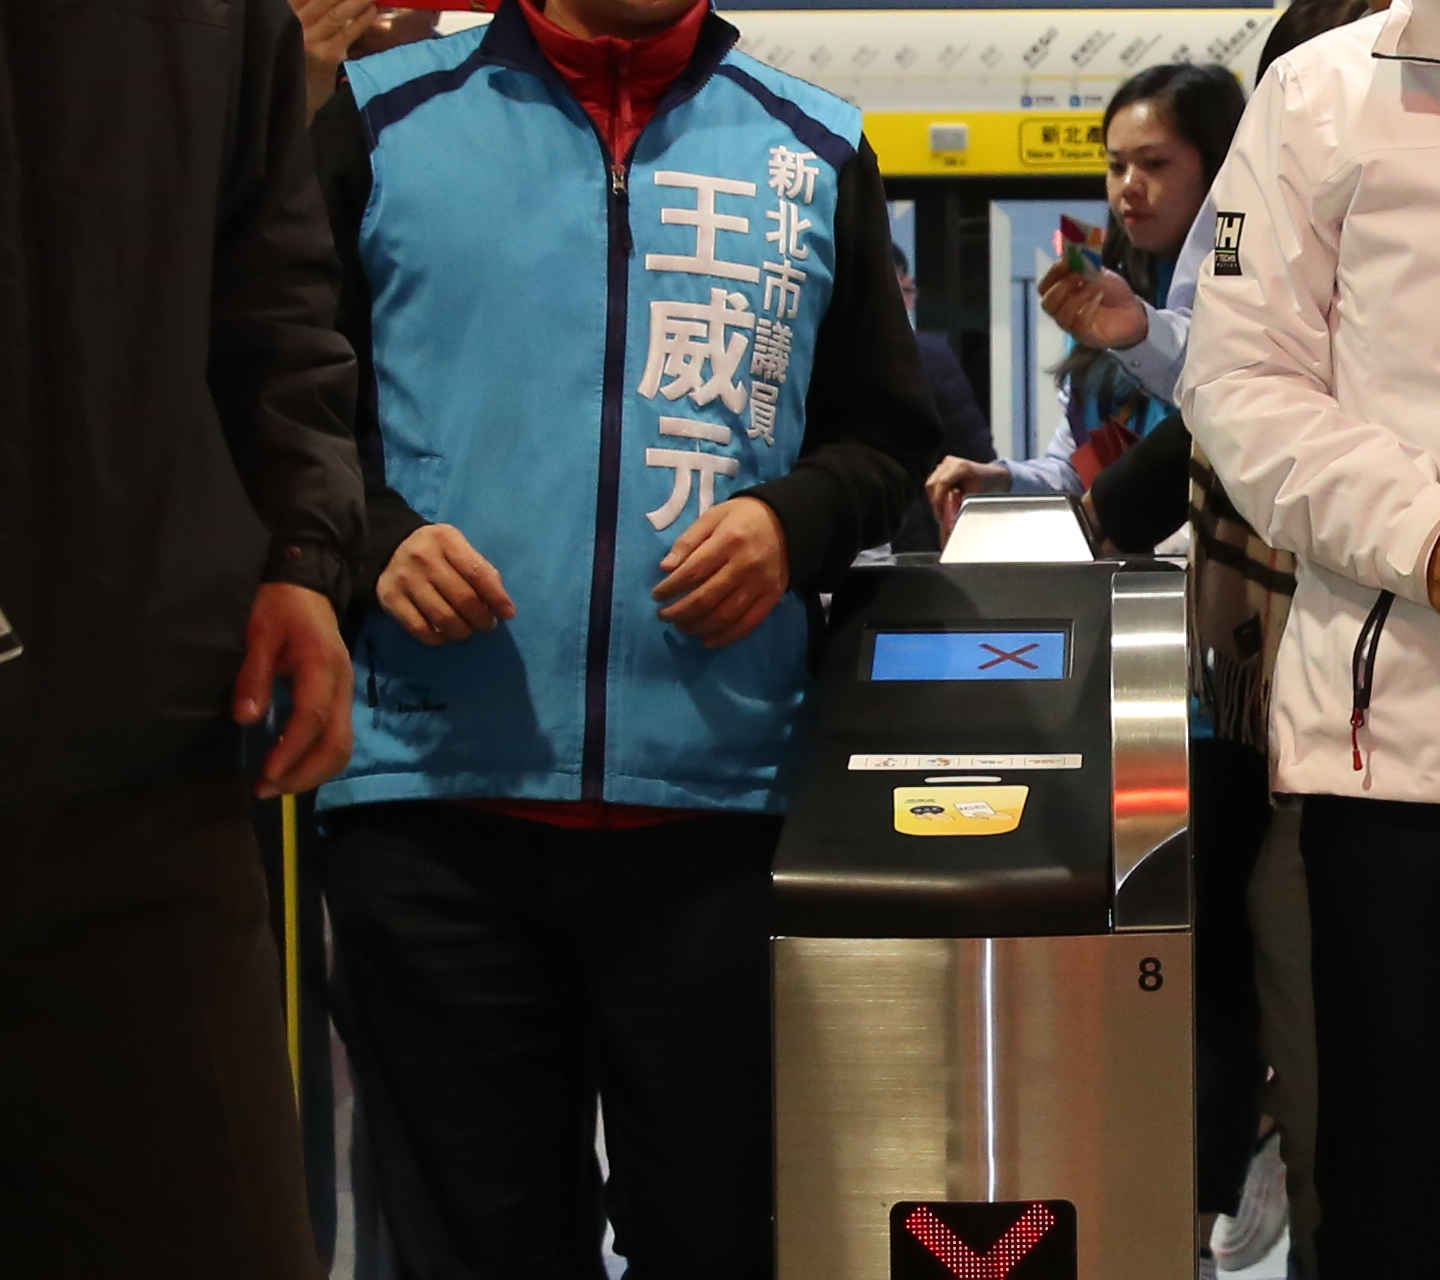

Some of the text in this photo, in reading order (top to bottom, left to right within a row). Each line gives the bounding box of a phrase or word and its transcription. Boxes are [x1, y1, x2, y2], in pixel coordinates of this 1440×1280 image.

[636, 169, 760, 532] 王威元
[747, 145, 820, 447] 新北市議員
[1137, 957, 1164, 992] 8
